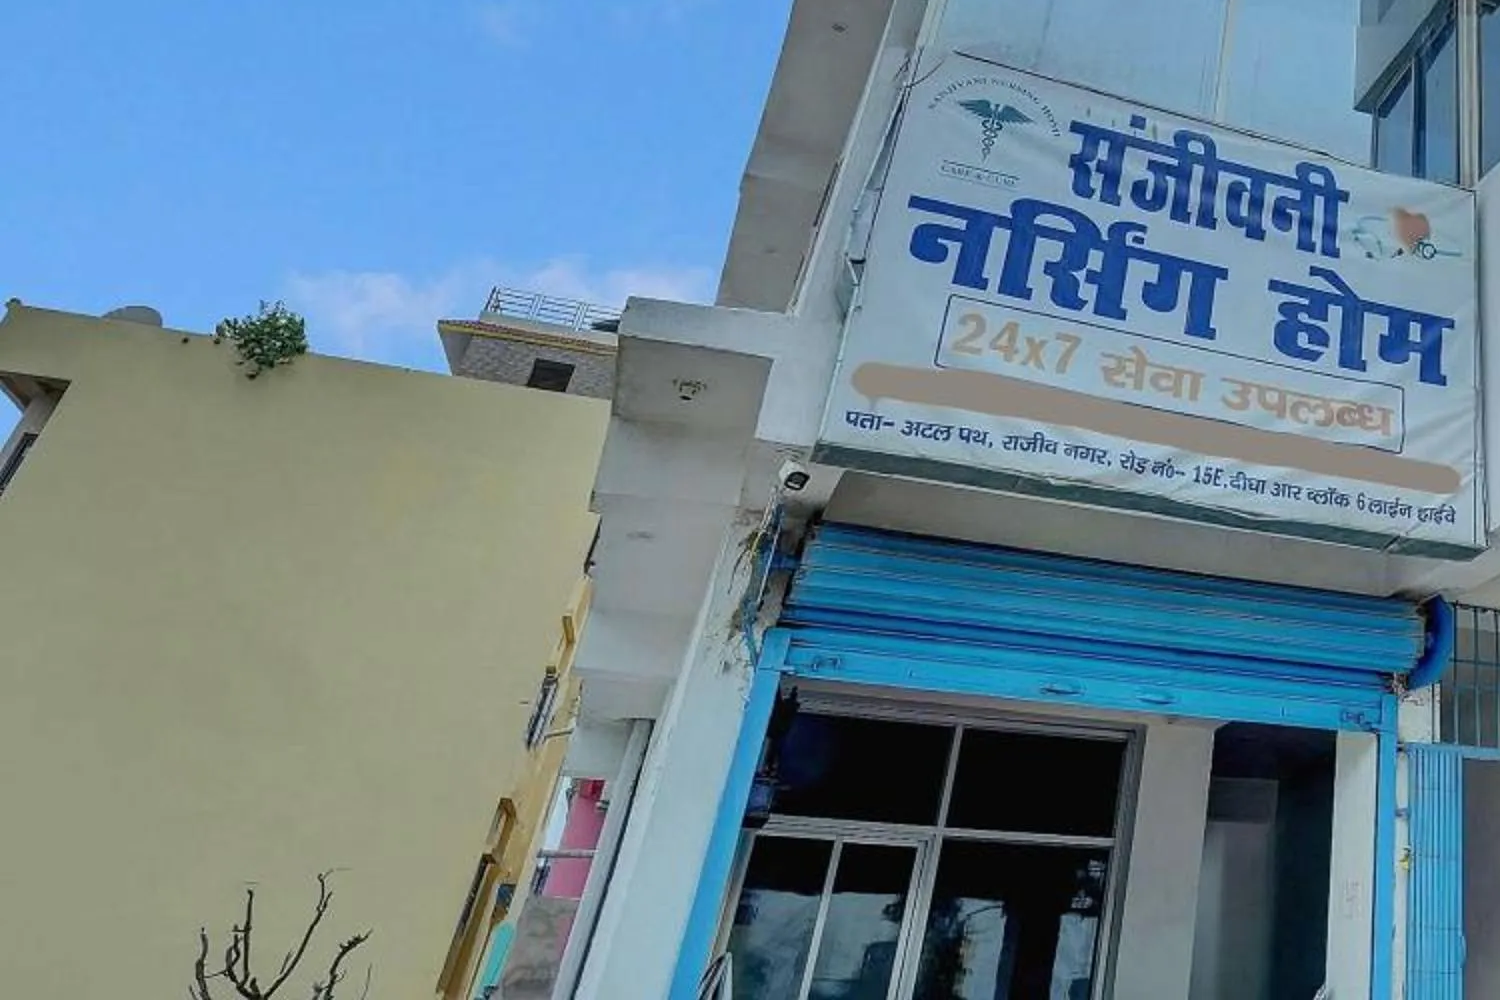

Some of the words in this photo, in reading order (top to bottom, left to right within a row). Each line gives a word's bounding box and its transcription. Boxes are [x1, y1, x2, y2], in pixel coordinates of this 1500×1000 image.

[1067, 116, 1350, 259] संजीवनी
[908, 194, 1229, 340] नर्सिंग
[1268, 265, 1455, 387] होम
[949, 312, 1083, 375] 24x7
[1100, 345, 1207, 403] सेवा
[1219, 376, 1397, 437] उपलब्ध
[900, 418, 954, 442] अटल
[1001, 431, 1057, 456] राजीव
[1119, 451, 1150, 475] रोड
[1270, 480, 1303, 502] आर
[1357, 492, 1366, 512] 6
